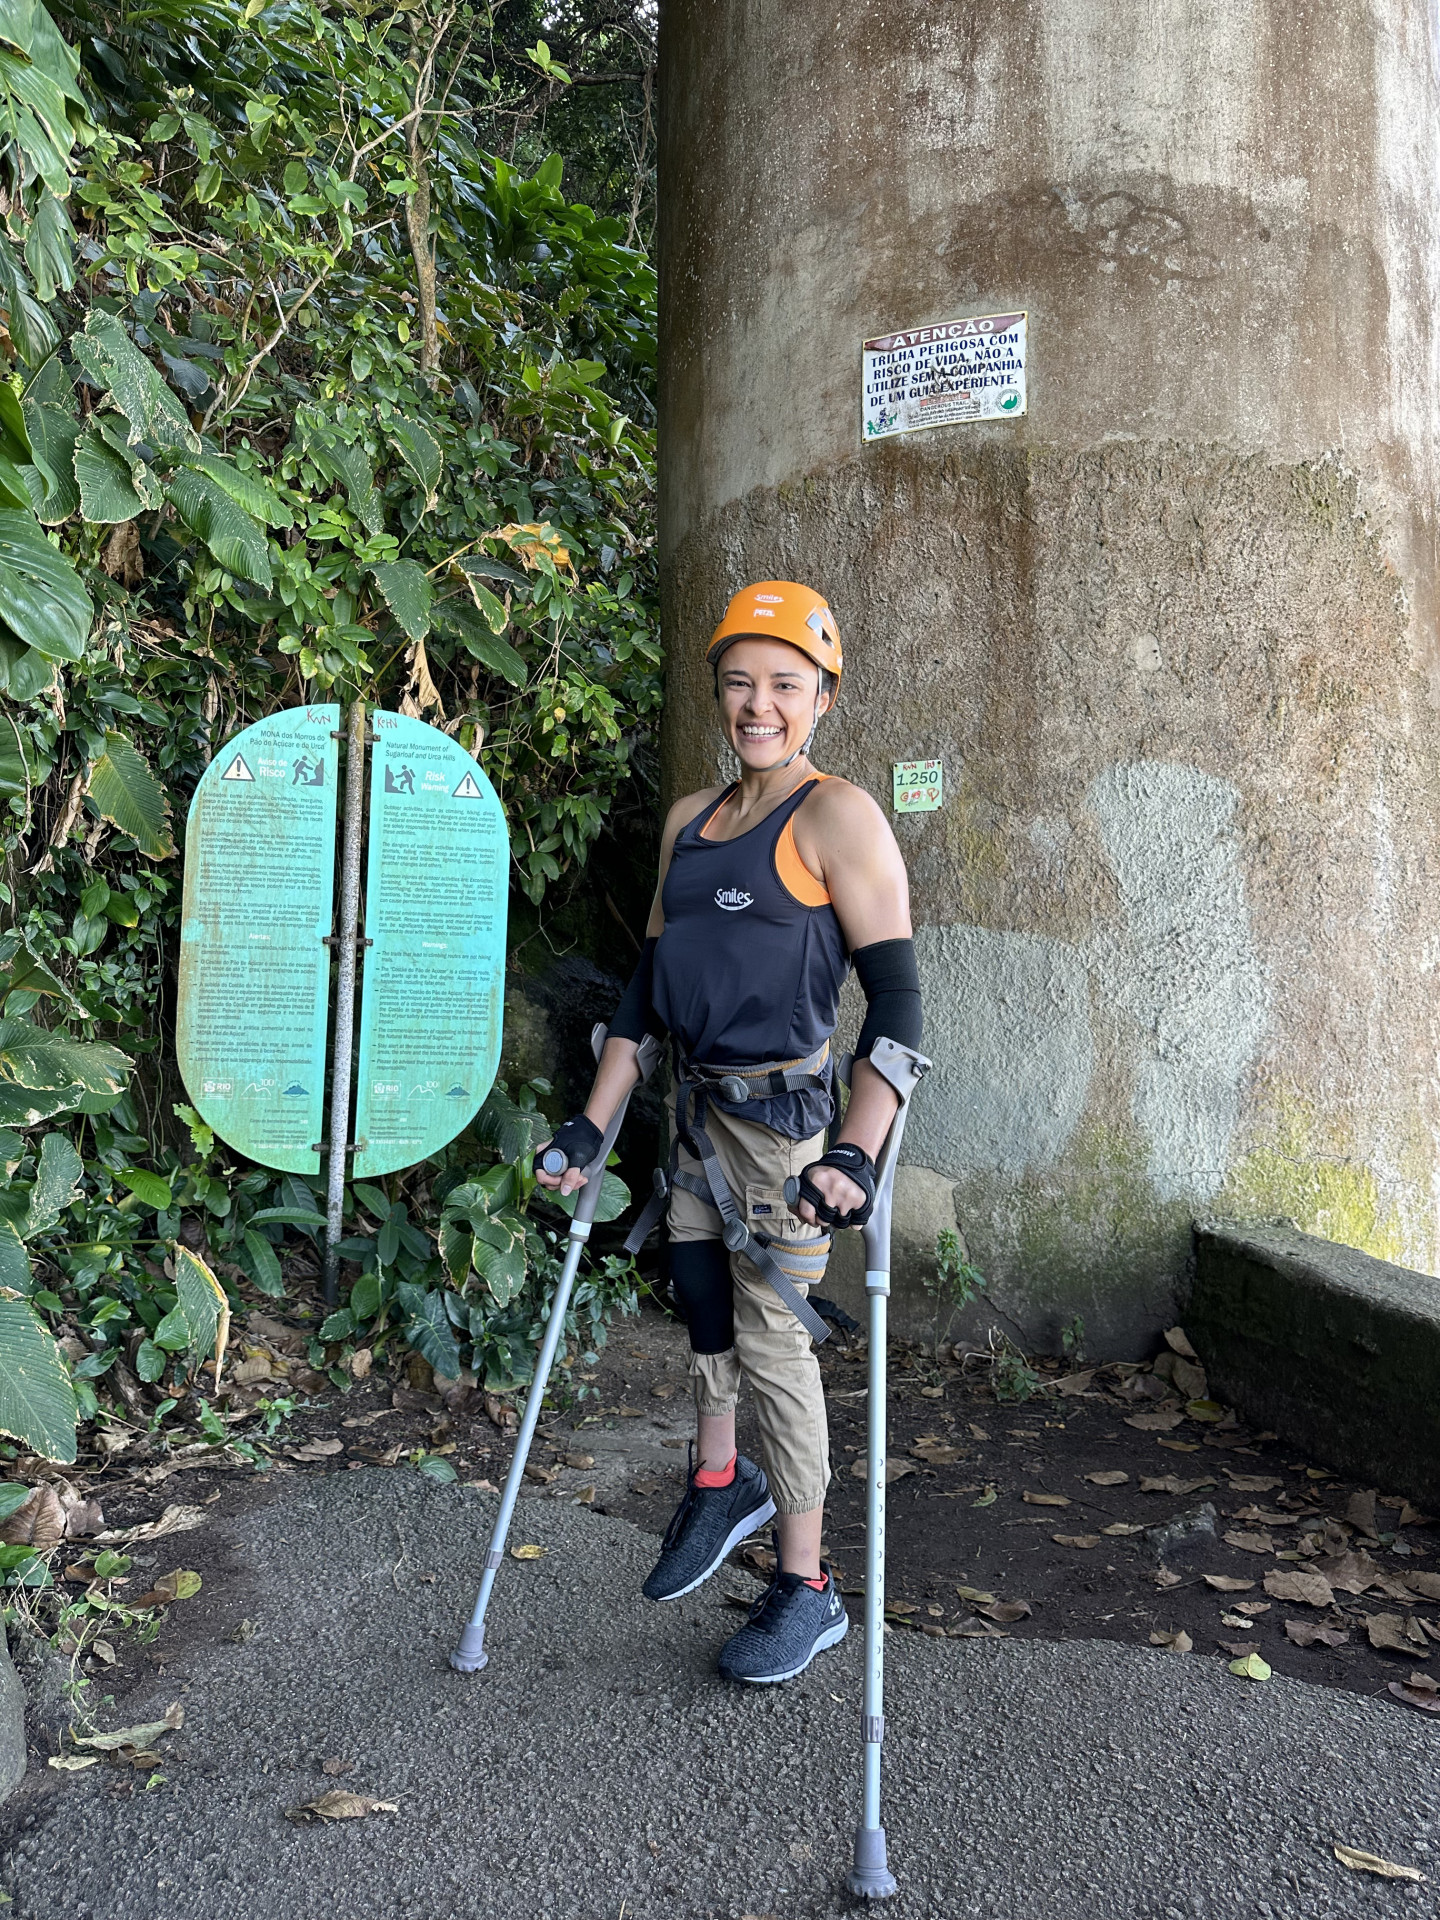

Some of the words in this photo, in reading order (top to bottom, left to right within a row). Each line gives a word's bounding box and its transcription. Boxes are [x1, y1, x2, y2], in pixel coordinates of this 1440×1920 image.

[893, 320, 994, 348] ATENÇÃO
[871, 350, 914, 368] TRILHA
[920, 338, 984, 356] PERIGOSA
[990, 333, 1018, 346] COM
[874, 363, 910, 380] RISCO
[916, 359, 932, 371] DE
[936, 352, 970, 367] VIDA,
[974, 347, 1001, 361] NÃO
[1006, 347, 1014, 358] A
[867, 377, 908, 394] UTILIZE
[911, 370, 935, 384] SEM
[950, 359, 1022, 377] COMPANHIA
[870, 396, 885, 407] DE
[888, 390, 905, 403] UM
[910, 385, 937, 399] GUIA
[940, 374, 1018, 393] EXPERIENTE.
[755, 593, 784, 602] Smiles
[273, 740, 294, 748] Açúcar
[409, 743, 441, 751] Monument
[385, 750, 414, 758] Sugarloaf
[258, 757, 277, 766] Aviso
[259, 766, 285, 778] Risco
[425, 771, 446, 781] Risk
[897, 771, 938, 786] 1.250
[421, 783, 449, 794] Warning
[714, 888, 752, 906] Smiles
